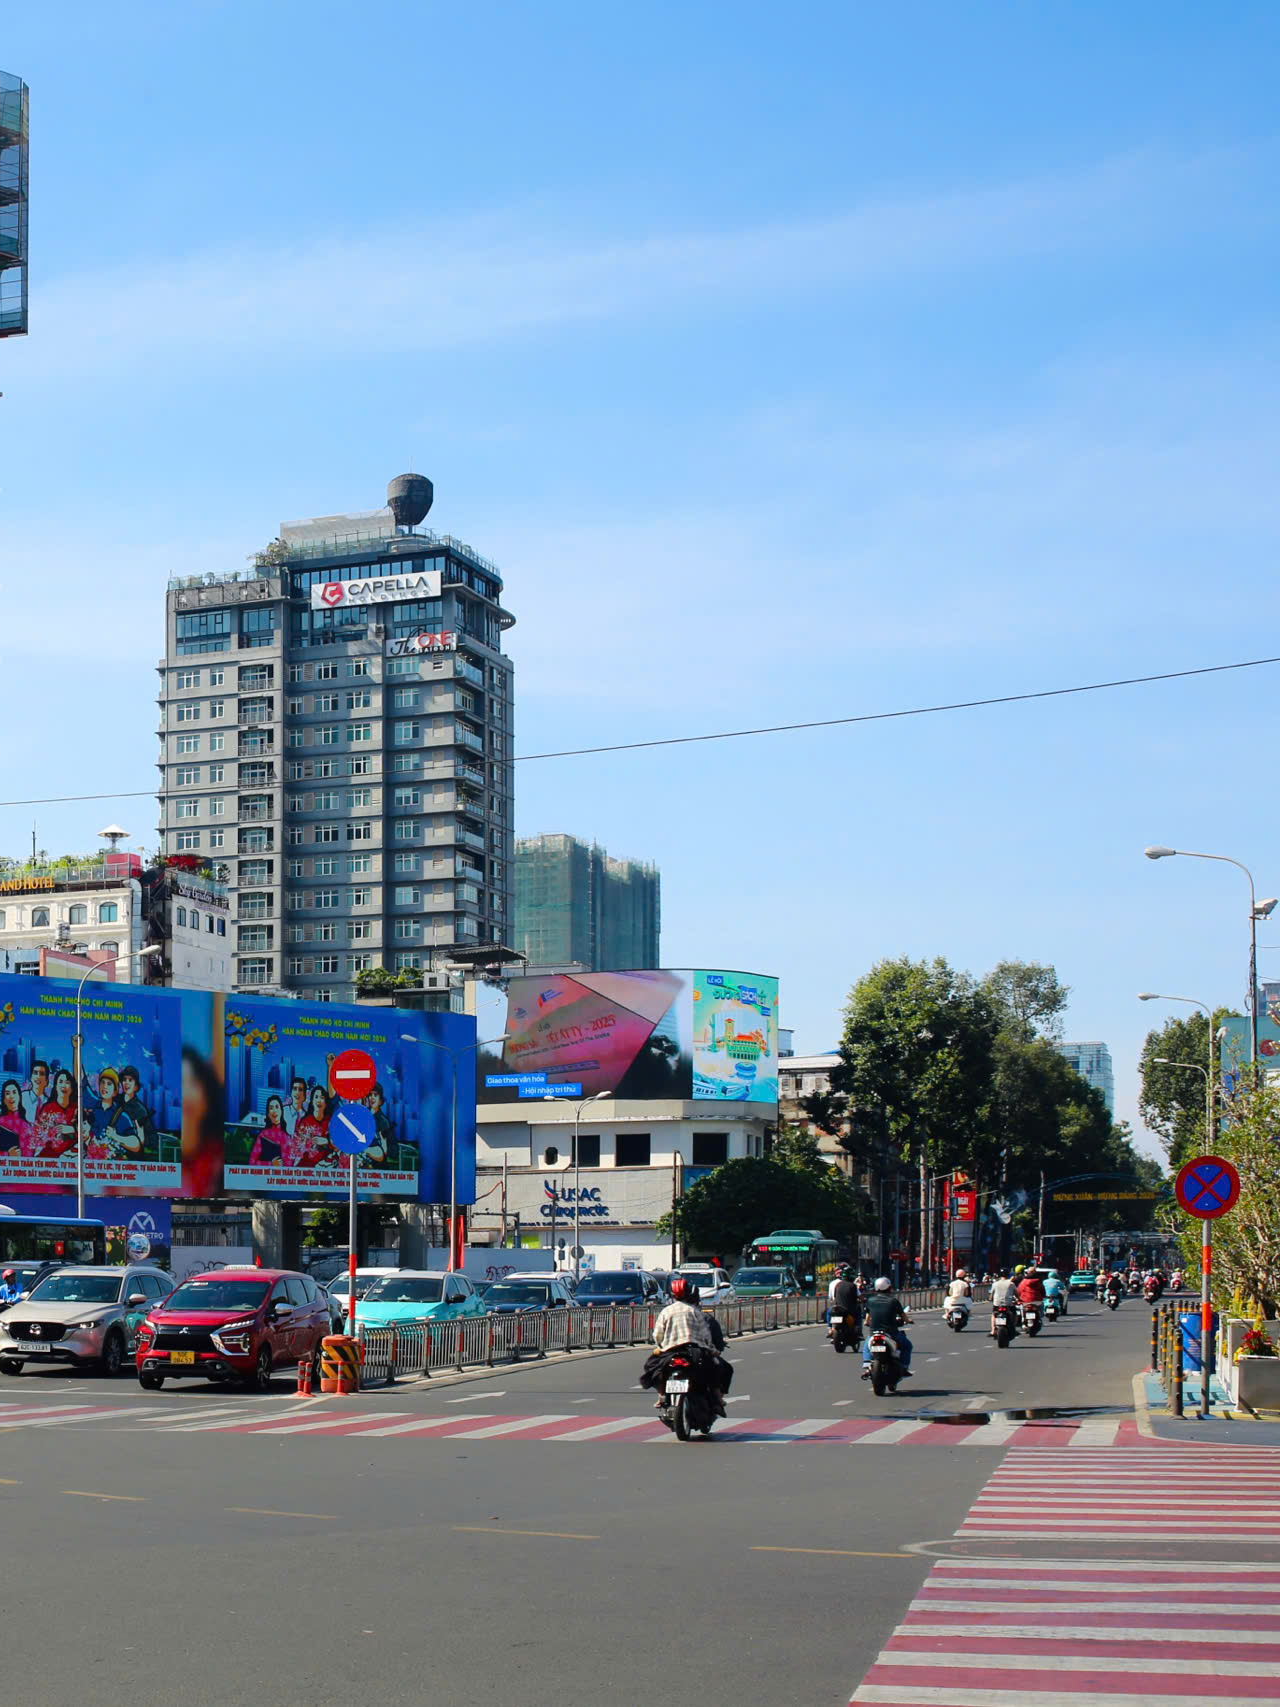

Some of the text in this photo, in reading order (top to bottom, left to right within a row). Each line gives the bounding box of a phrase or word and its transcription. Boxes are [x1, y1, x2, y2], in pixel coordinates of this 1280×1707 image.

[348, 576, 429, 595] CAPELLA
[417, 630, 453, 648] ONE
[23, 876, 55, 889] HOTEL
